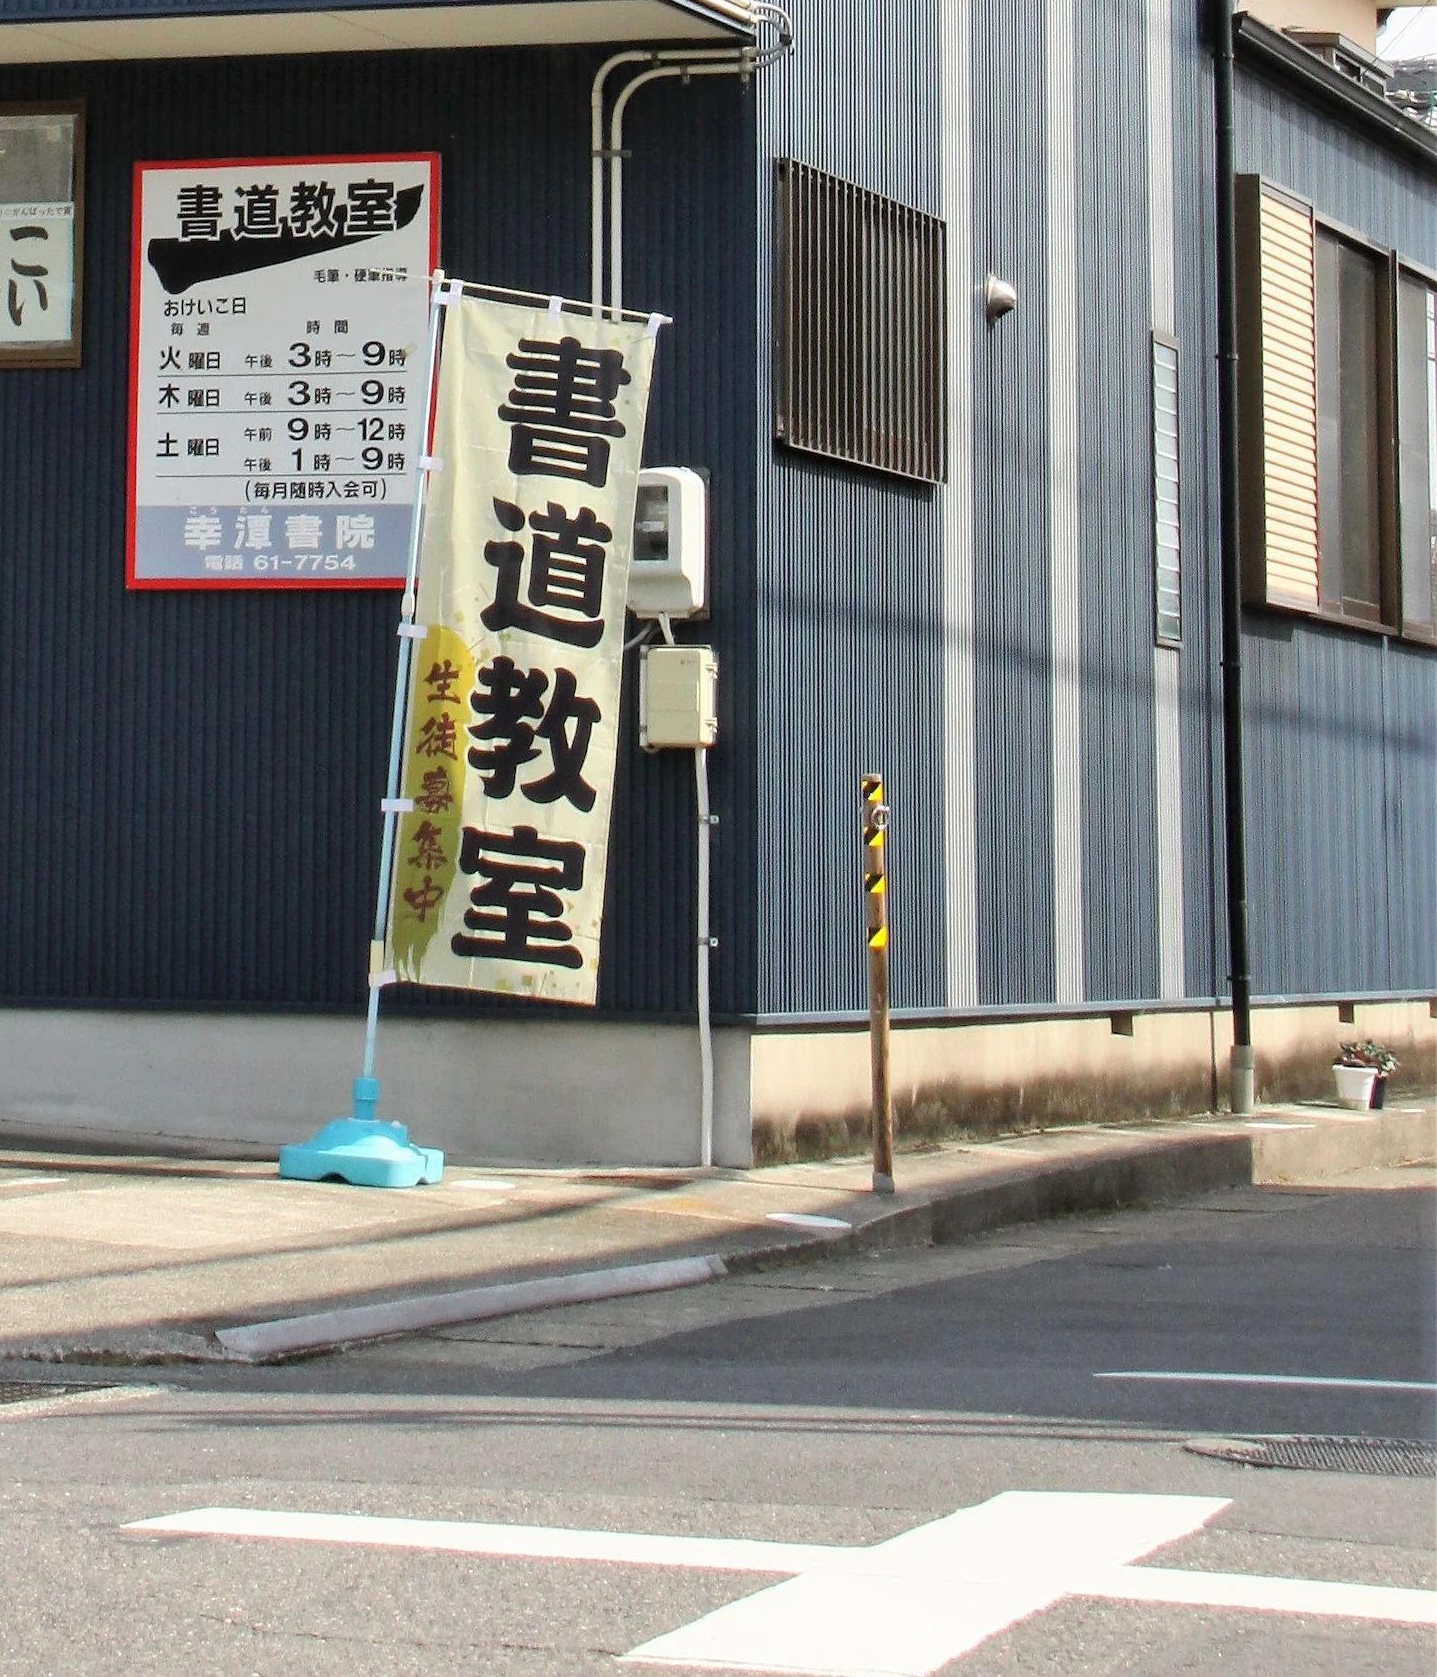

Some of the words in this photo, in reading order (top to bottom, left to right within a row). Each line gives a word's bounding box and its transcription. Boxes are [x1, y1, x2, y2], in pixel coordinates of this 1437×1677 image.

[176, 178, 397, 241] 書道教室
[10, 226, 49, 327] こい
[164, 297, 247, 317] おけいこ日
[244, 354, 272, 368] 午後
[244, 391, 272, 406] 午後
[244, 428, 272, 442] 午前
[244, 458, 272, 472] 午後
[204, 555, 244, 571] 電話
[253, 554, 357, 571] 61-7754
[450, 335, 632, 970] 書道教室
[403, 658, 461, 923] 生徒募集中
